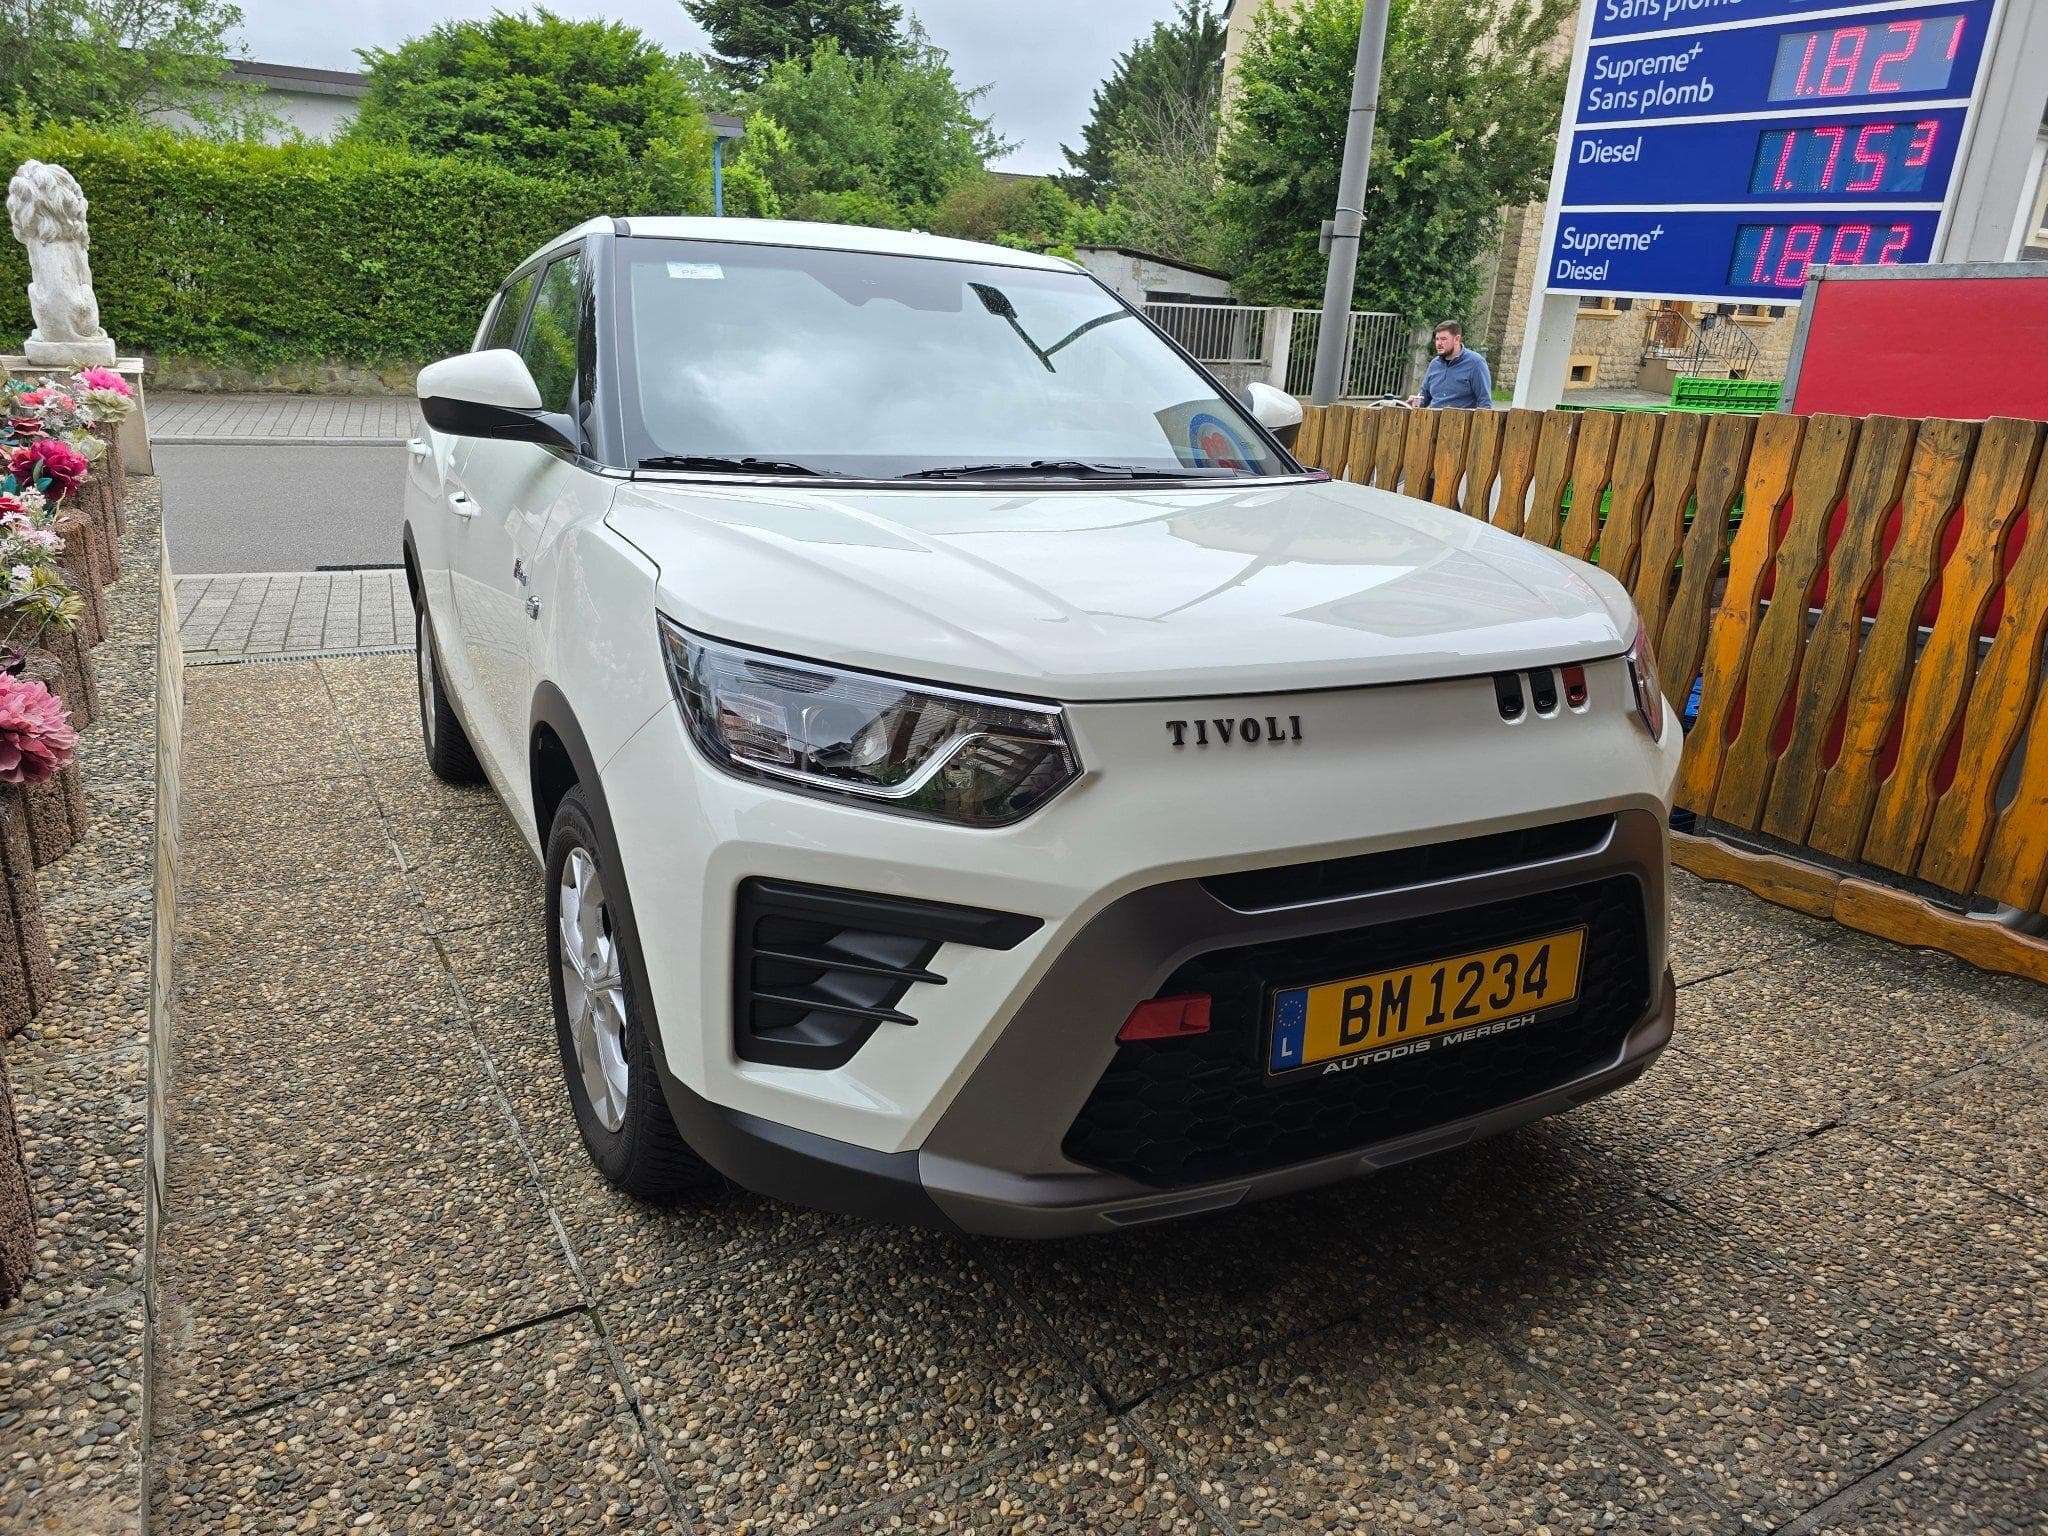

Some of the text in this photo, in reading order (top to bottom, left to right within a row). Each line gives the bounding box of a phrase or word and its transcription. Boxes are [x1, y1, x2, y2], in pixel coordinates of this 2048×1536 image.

[1604, 0, 1660, 21] Sans
[1587, 79, 1714, 114] Sans plomb
[1578, 136, 1642, 164] Diesel
[1556, 259, 1610, 281] Diesel
[1166, 715, 1303, 746] TIVOLI
[1339, 944, 1551, 1047] BM 1234
[1280, 1036, 1293, 1059] L
[1321, 1014, 1536, 1076] AUTODIS MERSCH
